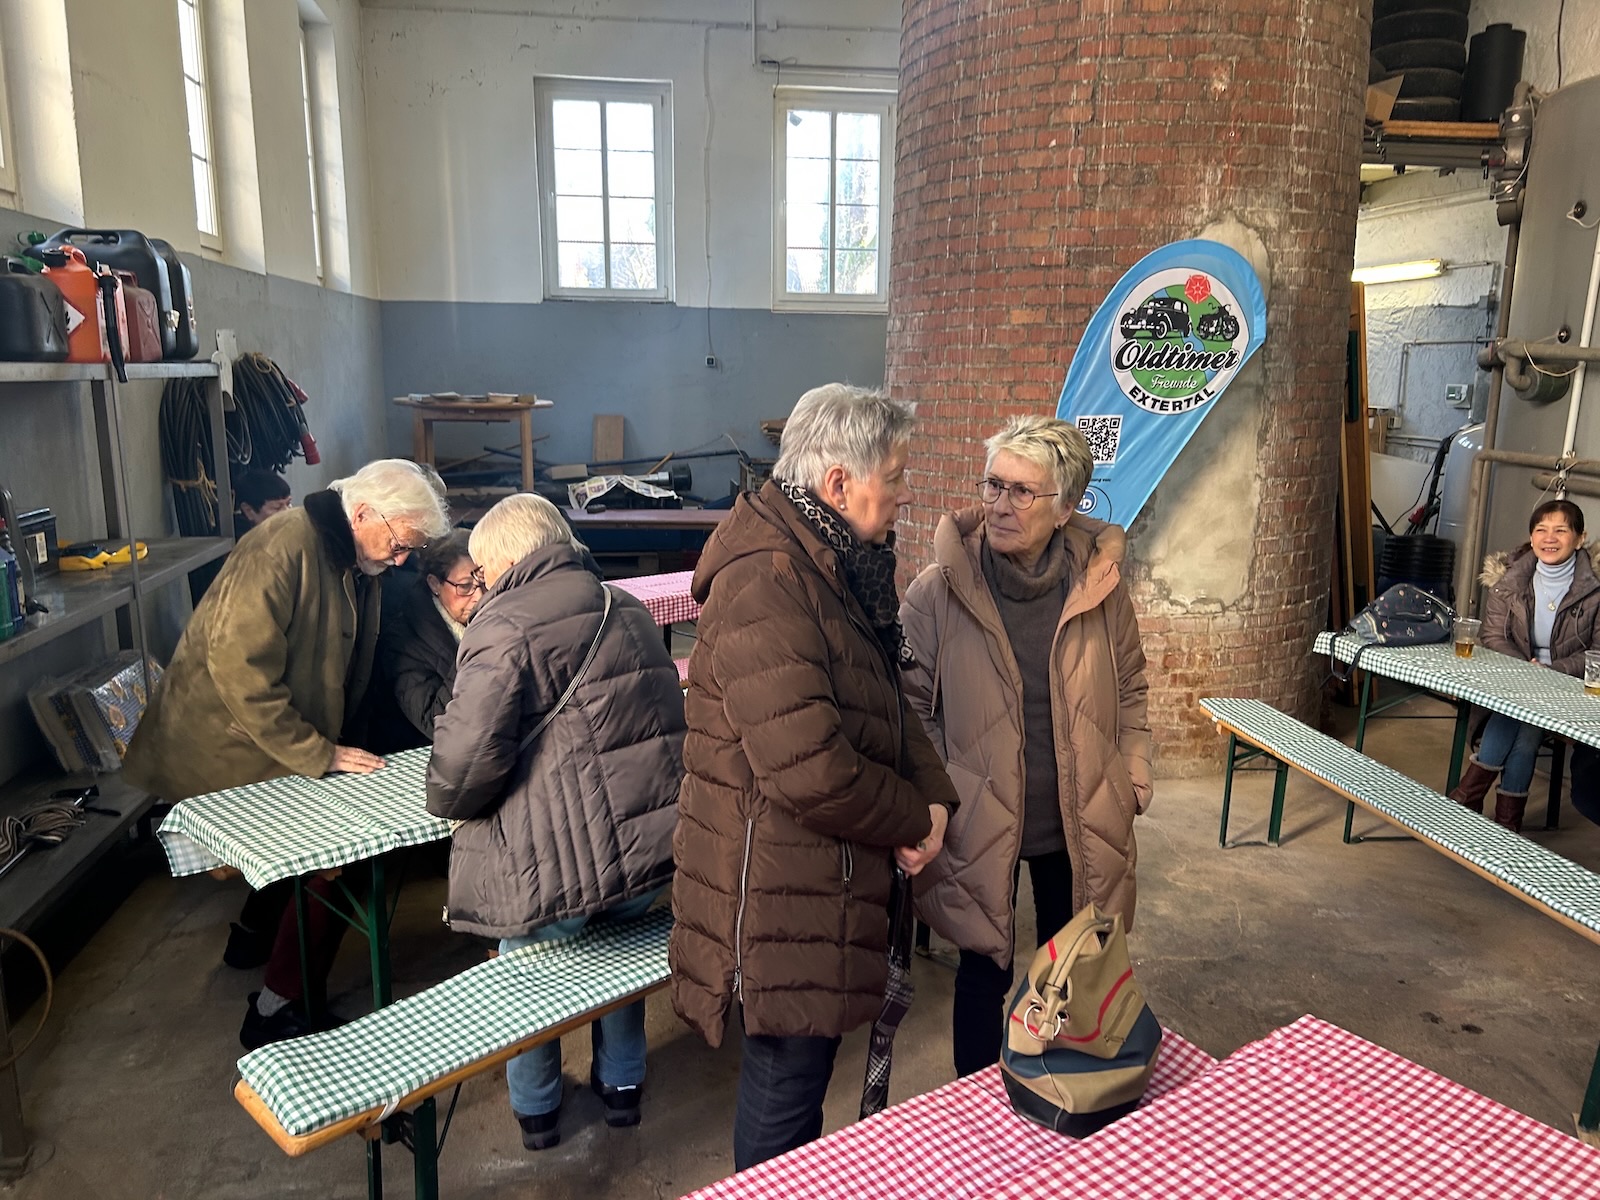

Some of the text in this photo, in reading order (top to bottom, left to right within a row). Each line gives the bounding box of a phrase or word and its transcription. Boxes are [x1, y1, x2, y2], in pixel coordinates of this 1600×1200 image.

[1115, 340, 1240, 371] Oldtimer
[1151, 374, 1198, 389] Freunde
[1129, 385, 1215, 411] EXTERTAL
